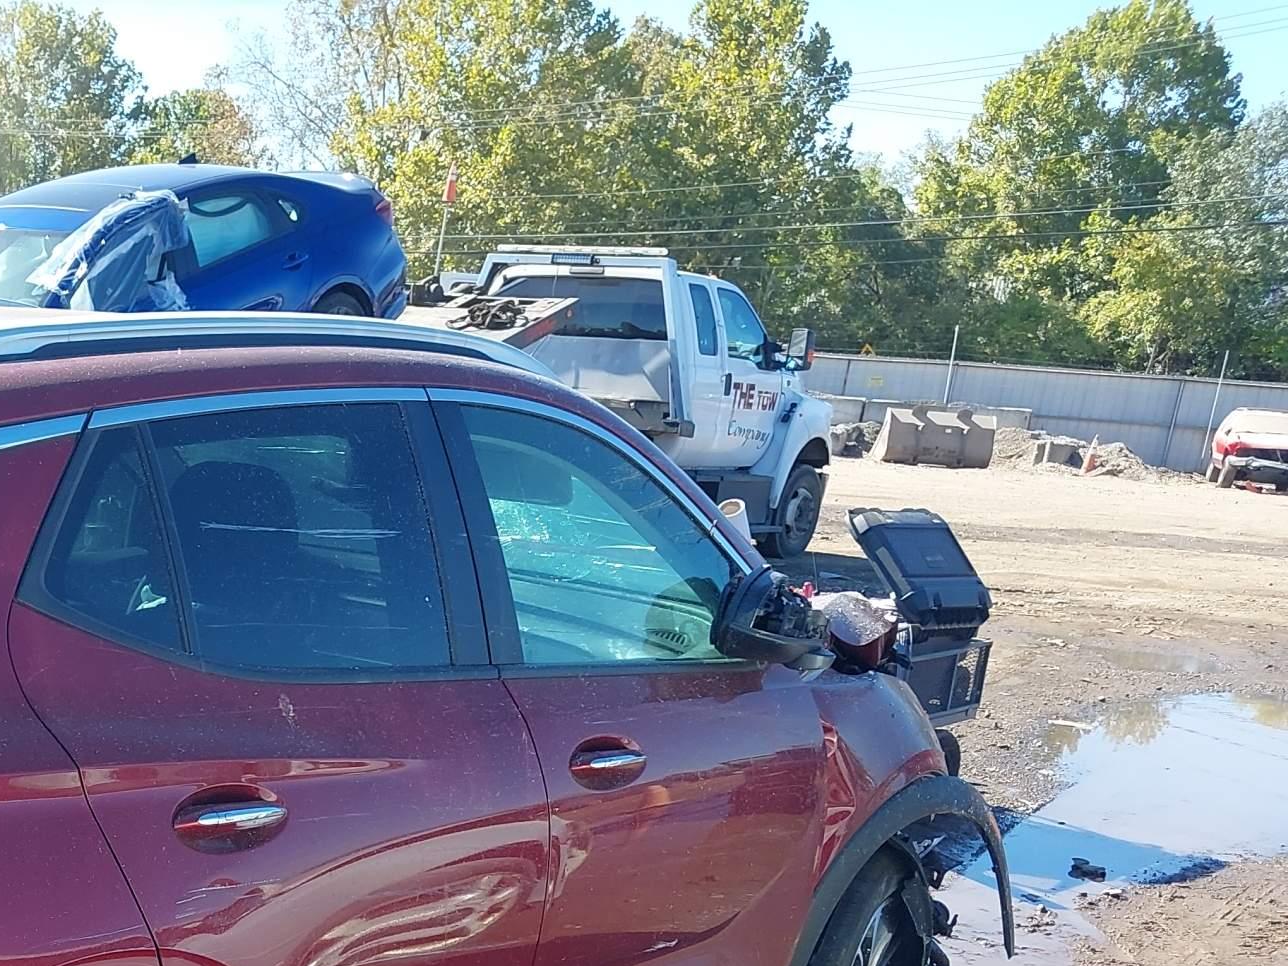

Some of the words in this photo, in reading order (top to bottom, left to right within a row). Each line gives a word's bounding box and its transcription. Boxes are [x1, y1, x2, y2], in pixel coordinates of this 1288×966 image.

[733, 382, 755, 409] THE
[757, 391, 778, 411] TOW
[728, 420, 770, 449] Company
